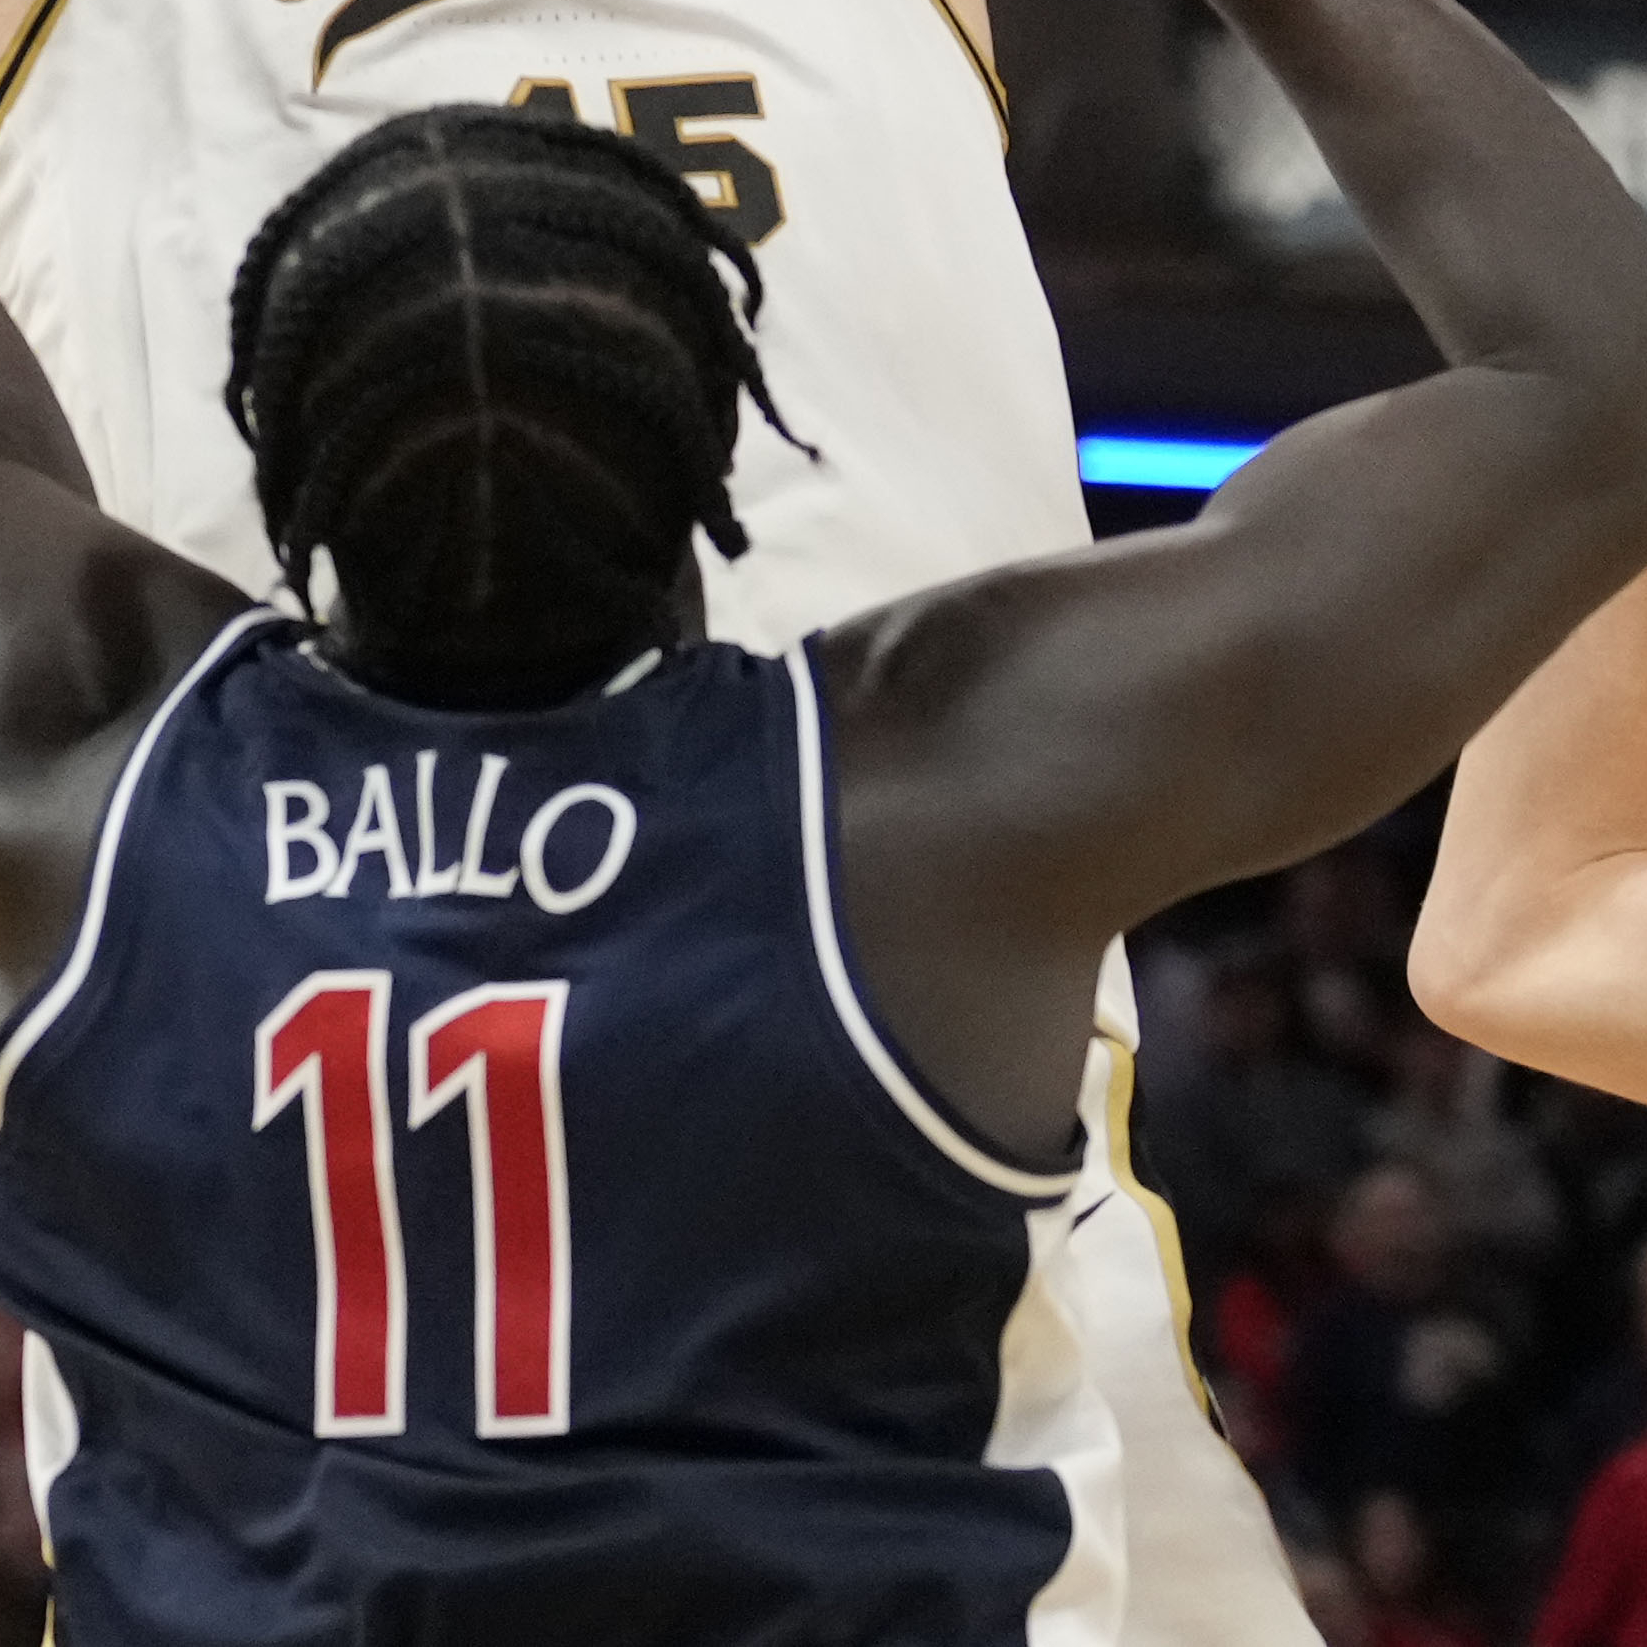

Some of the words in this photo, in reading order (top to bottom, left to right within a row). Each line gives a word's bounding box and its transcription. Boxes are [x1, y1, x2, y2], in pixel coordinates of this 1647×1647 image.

[507, 71, 787, 249] 5
[262, 748, 638, 916] BALLO
[252, 968, 571, 1441] 11
